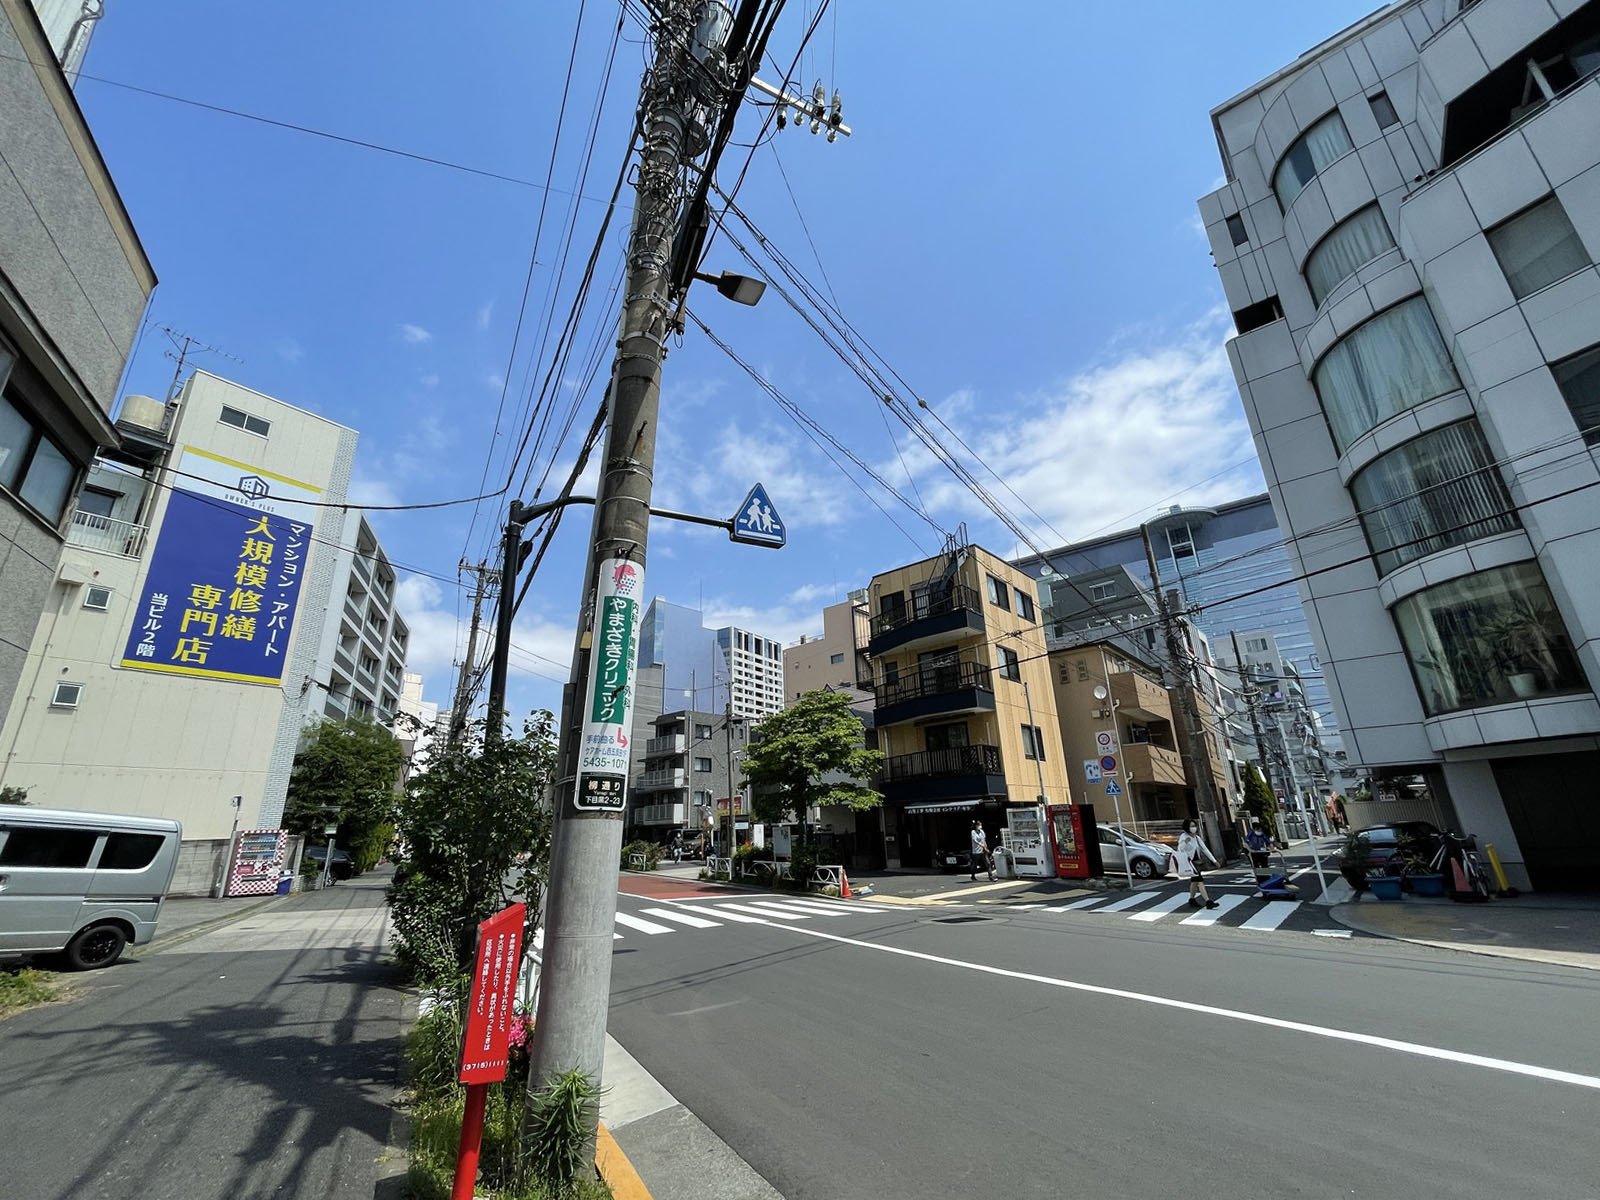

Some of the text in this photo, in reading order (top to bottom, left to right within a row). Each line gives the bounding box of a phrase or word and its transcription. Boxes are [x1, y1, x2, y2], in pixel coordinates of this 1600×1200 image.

[225, 494, 275, 512] OWNER'S PLUS
[220, 515, 277, 641] 大規模修繕
[264, 523, 306, 657] マンション・アパート
[136, 592, 168, 657] 当ビル2階
[171, 583, 227, 664] 専門店
[599, 597, 627, 722] やまざきクリニック
[583, 757, 627, 769] 5435-1071
